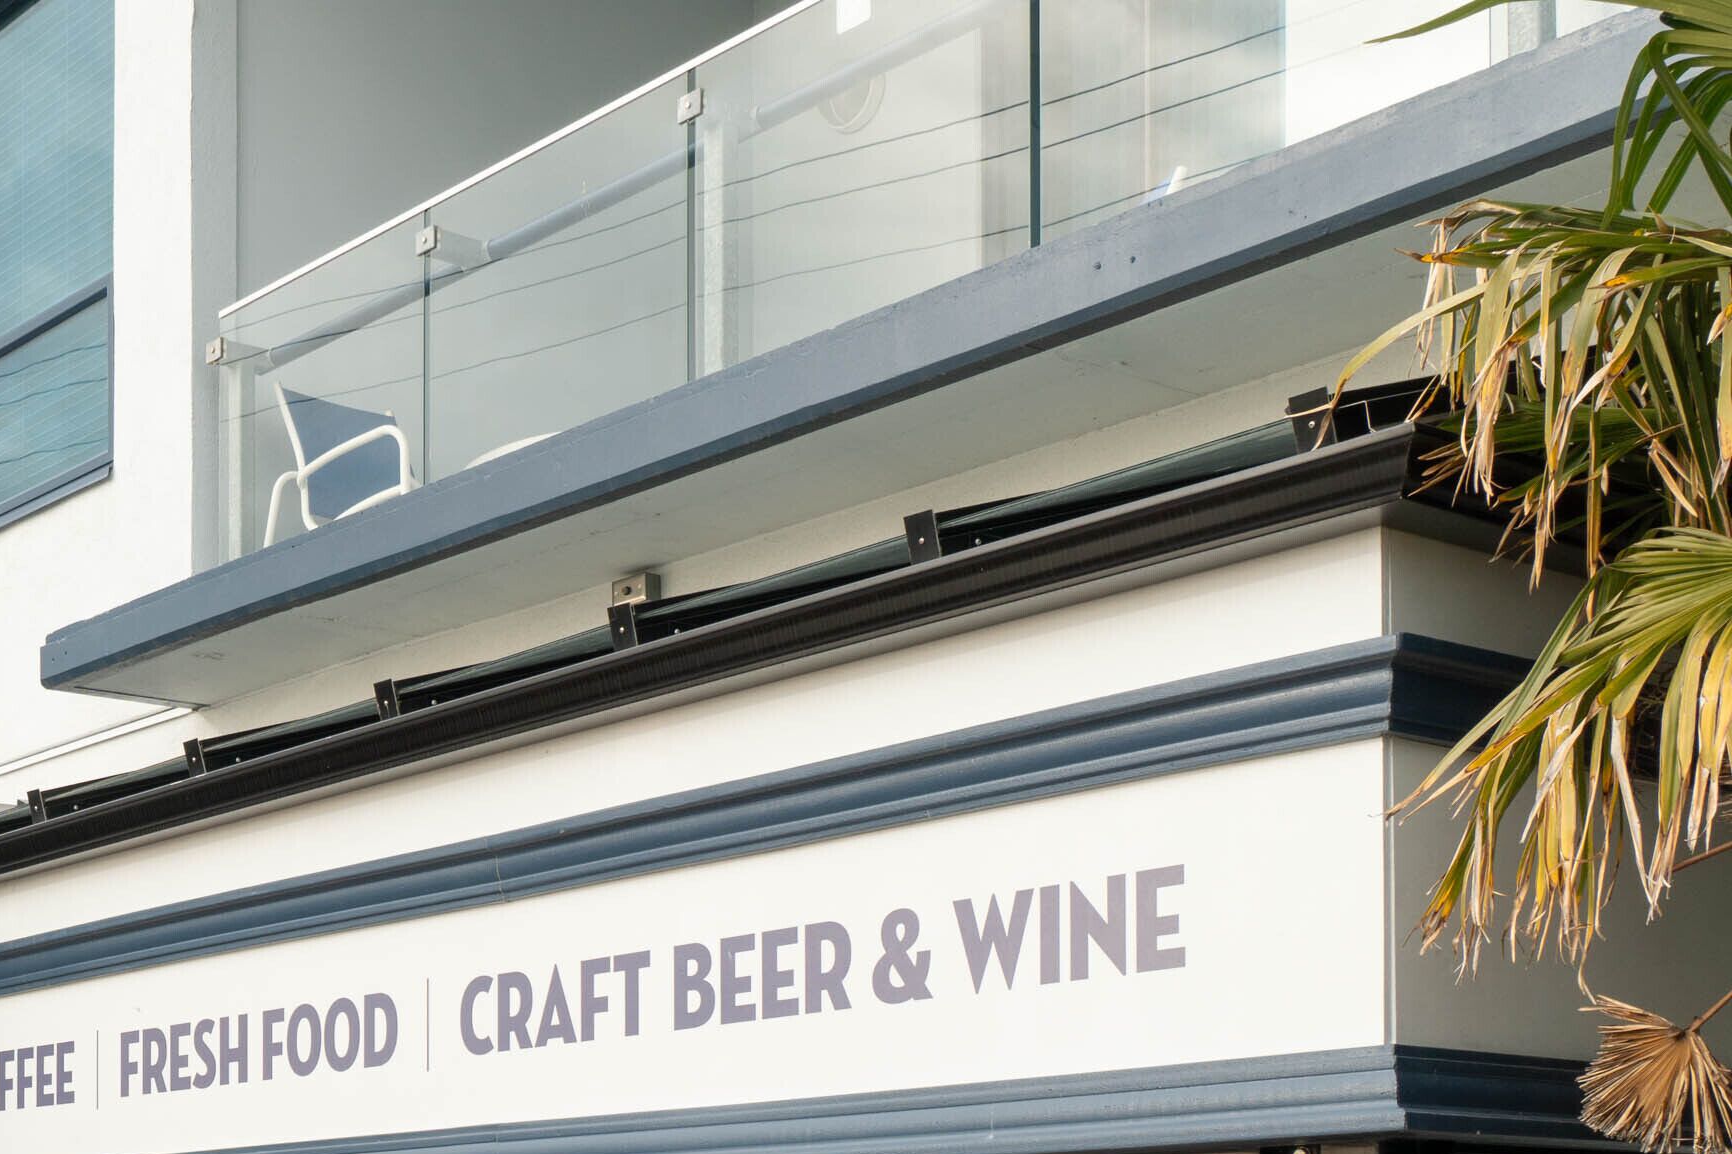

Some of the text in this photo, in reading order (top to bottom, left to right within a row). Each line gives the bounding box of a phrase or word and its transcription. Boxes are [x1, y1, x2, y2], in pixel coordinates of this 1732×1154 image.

[120, 1013, 248, 1098] FRESH
[262, 992, 398, 1081] FOOD
[460, 949, 651, 1056] CRAFT
[673, 921, 852, 1031] BEER
[872, 908, 934, 1004] &
[952, 863, 1186, 995] WINE
